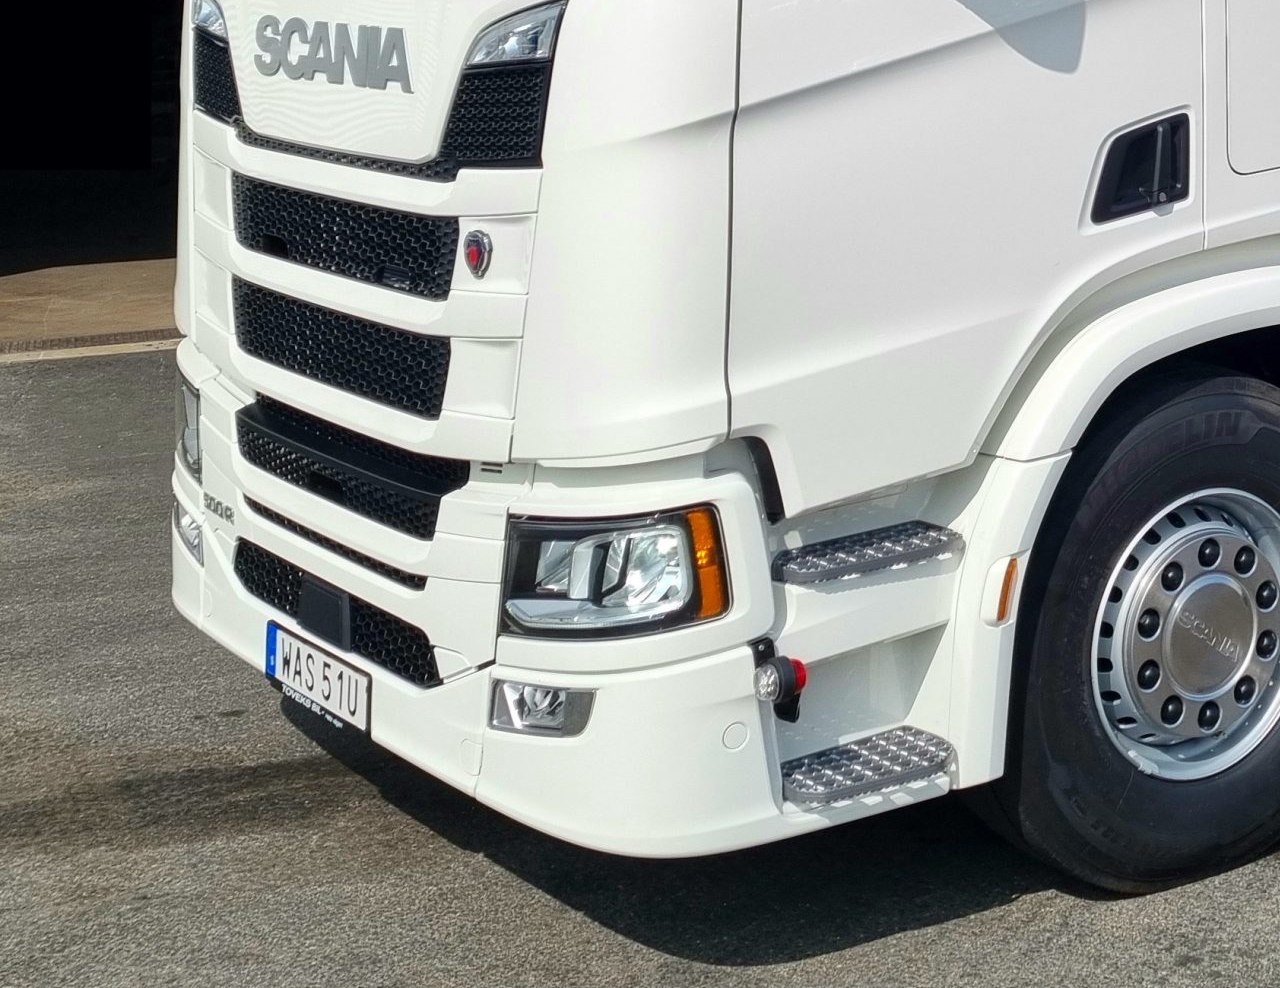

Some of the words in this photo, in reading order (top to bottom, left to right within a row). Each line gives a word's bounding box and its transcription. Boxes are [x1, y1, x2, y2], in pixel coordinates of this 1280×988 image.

[254, 14, 415, 94] SCANIA
[1178, 612, 1241, 663] SCANIA
[281, 637, 315, 692] WAS
[322, 660, 359, 717] 51U
[281, 683, 312, 709] TOVEKS
